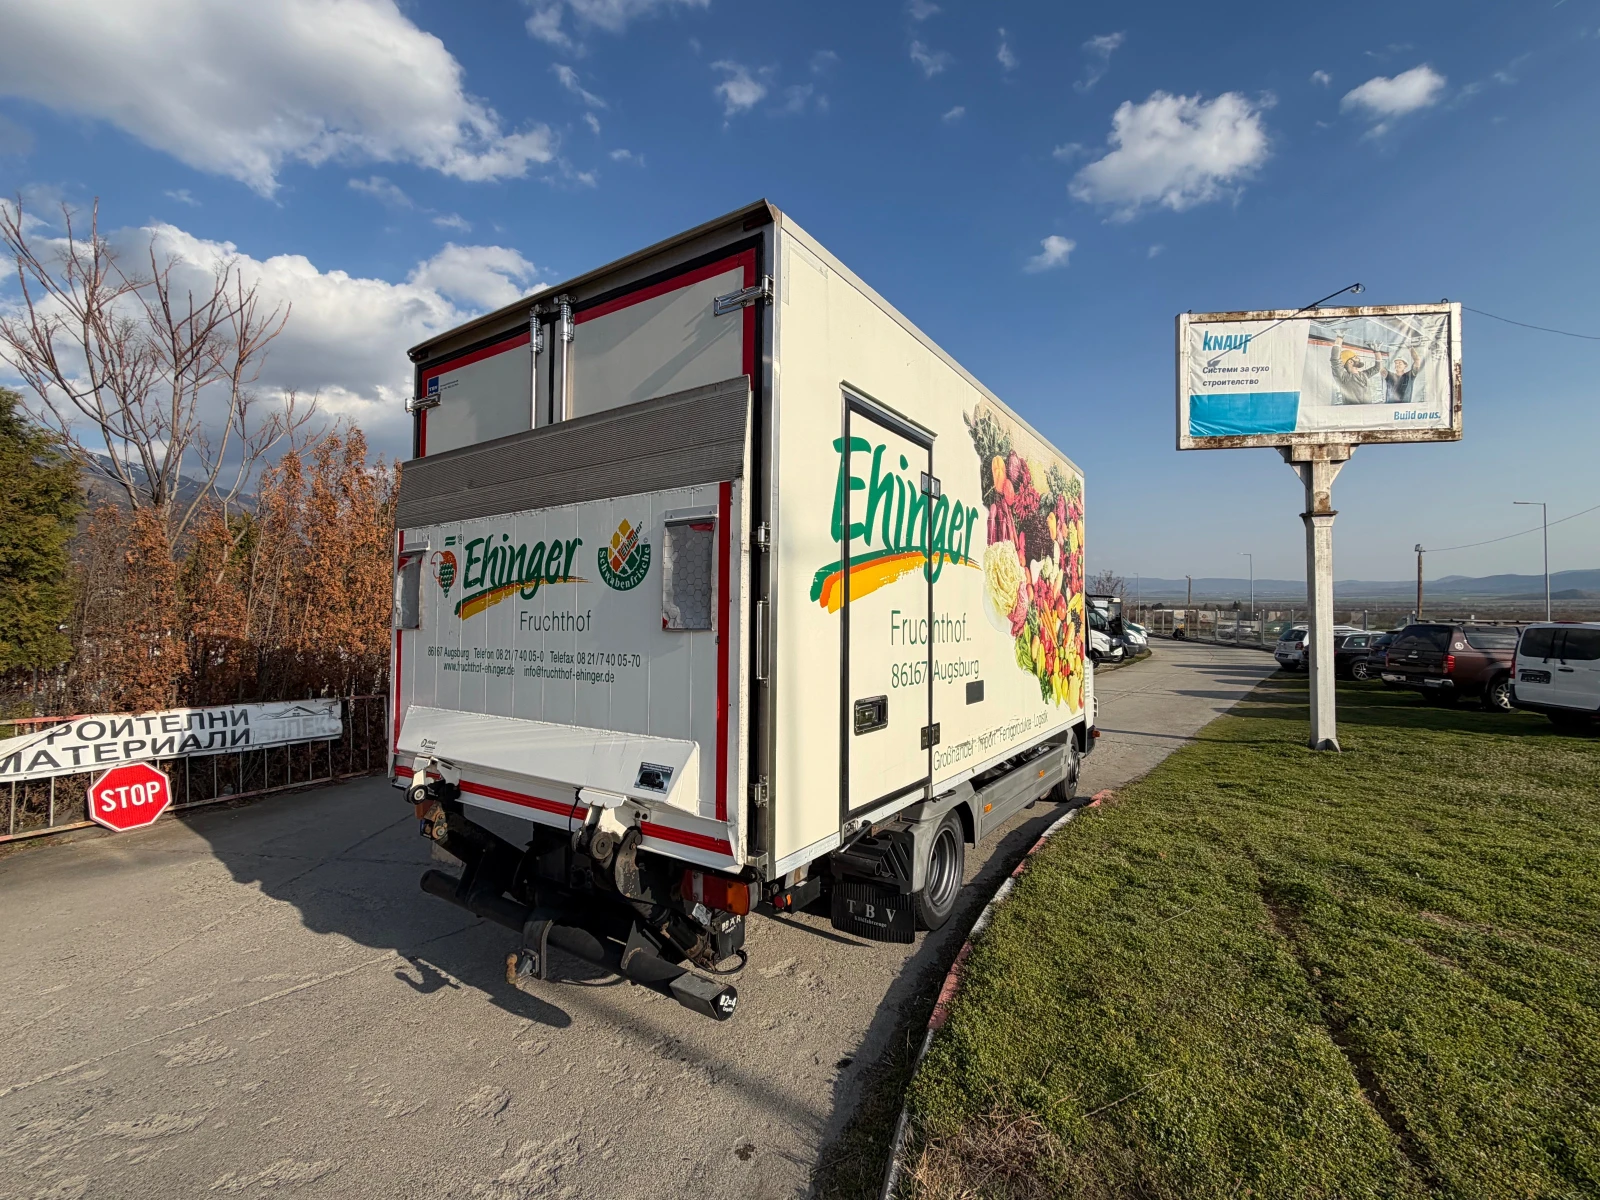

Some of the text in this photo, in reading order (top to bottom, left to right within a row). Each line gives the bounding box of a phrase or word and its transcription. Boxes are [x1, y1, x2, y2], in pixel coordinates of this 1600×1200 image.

[1202, 330, 1252, 354] KNAUF
[1202, 365, 1238, 374] Системи
[1250, 365, 1270, 374] сухо
[1202, 378, 1259, 387] строителство
[1393, 410, 1442, 421] Build on us.
[831, 437, 978, 583] Ehinger
[463, 533, 583, 600] Ehinger
[599, 546, 650, 589] Schwabenfrische
[520, 609, 592, 632] Fruchthof
[427, 646, 443, 657] 86167
[443, 647, 470, 660] Augsburg
[473, 647, 495, 659] Telefon
[528, 650, 544, 662] 05-0
[549, 651, 575, 664] Telefax
[576, 651, 586, 665] 08
[617, 653, 641, 667] 05-70
[443, 661, 615, 684] www.fruchthof-ehinger.de info@fruchthof-ehinger.de
[891, 656, 980, 688] 86167 Augsburg
[47, 708, 249, 746] РОИТЕЛНИ
[1034, 709, 1049, 728] Logistik
[101, 780, 161, 813] STOP
